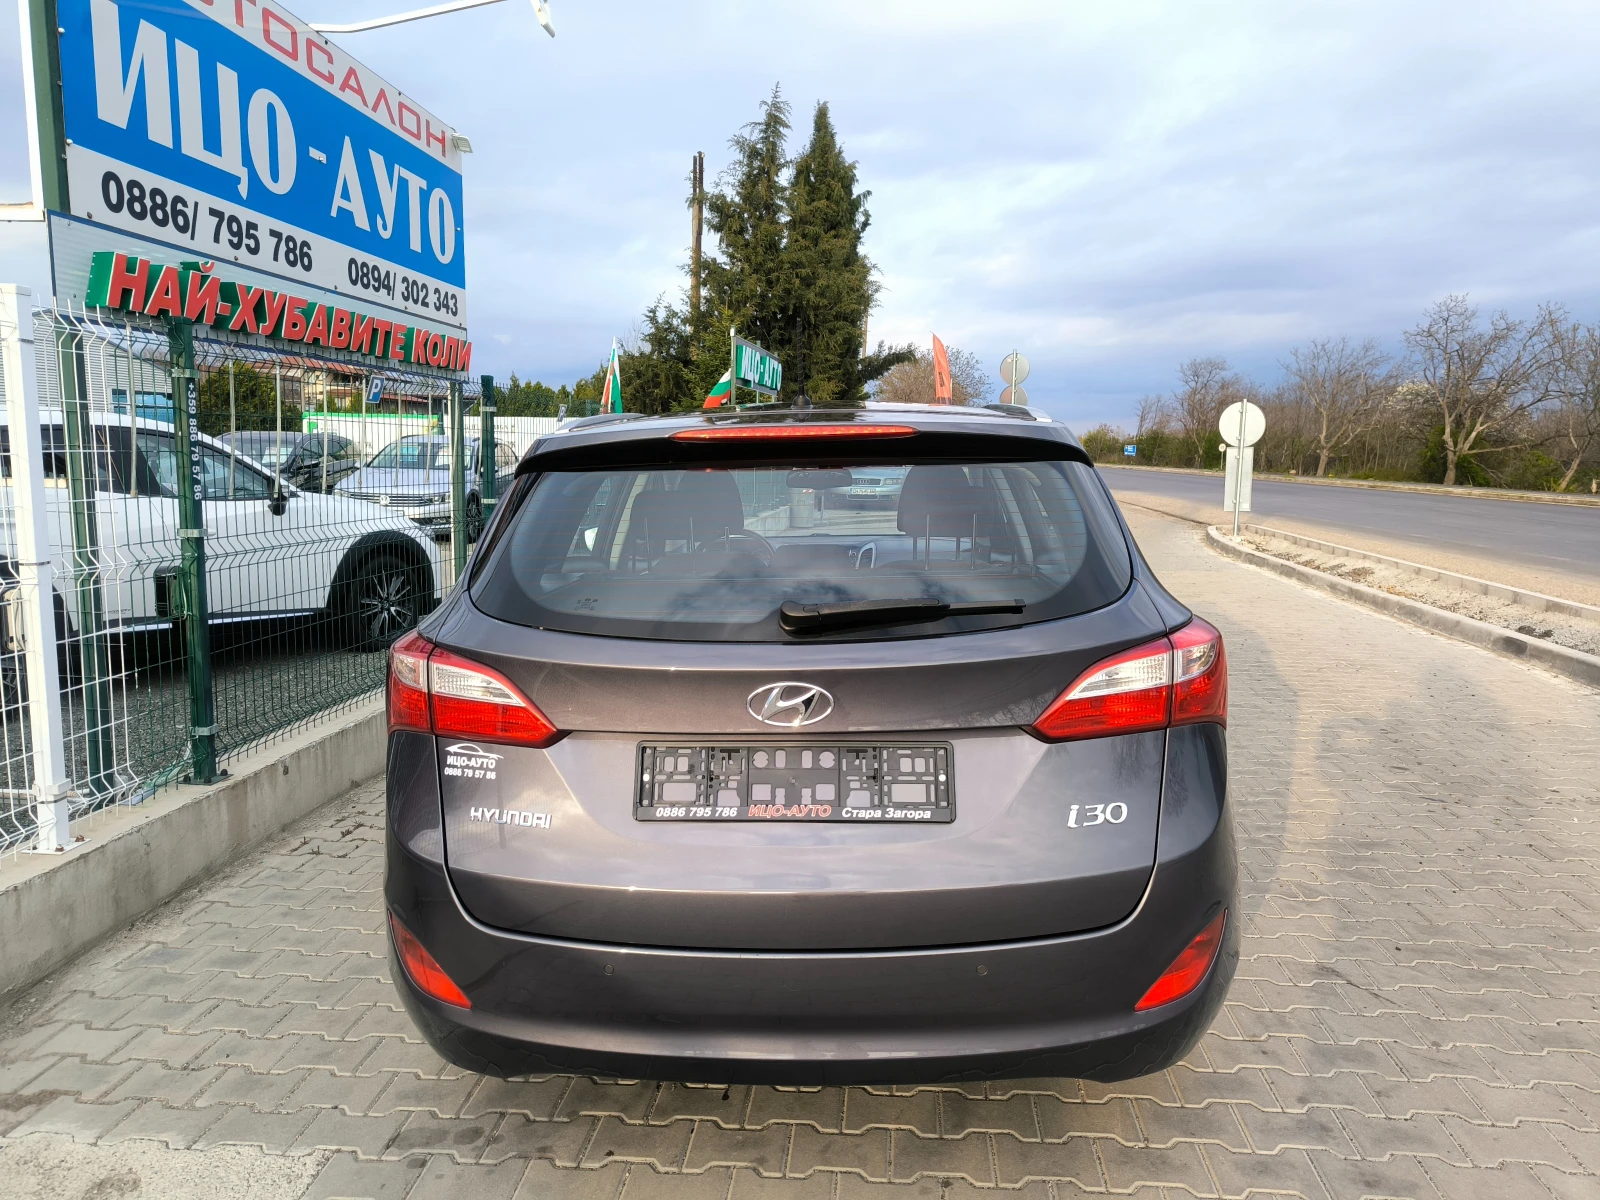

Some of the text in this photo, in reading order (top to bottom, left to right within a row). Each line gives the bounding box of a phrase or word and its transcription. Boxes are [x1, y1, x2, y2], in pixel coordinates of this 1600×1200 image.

[199, 0, 446, 158] ТОСАЛОН
[101, 170, 313, 272] 0886/ 795 786
[347, 257, 459, 317] 0894/ 302 343
[104, 251, 472, 372] НАЙ-ХУБАВИТЕ КОЛИ
[741, 345, 782, 391] ИЦО-АУТО
[187, 382, 202, 500] +359 886 79 57 86
[444, 767, 497, 780] 0886 79 57 86
[446, 755, 496, 768] ИЦО-АУТО
[470, 807, 552, 829] HYUNDAI
[655, 804, 932, 820] 0886 795 786 ИЦО-АУТО Стара Загора
[1066, 801, 1128, 829] i30
